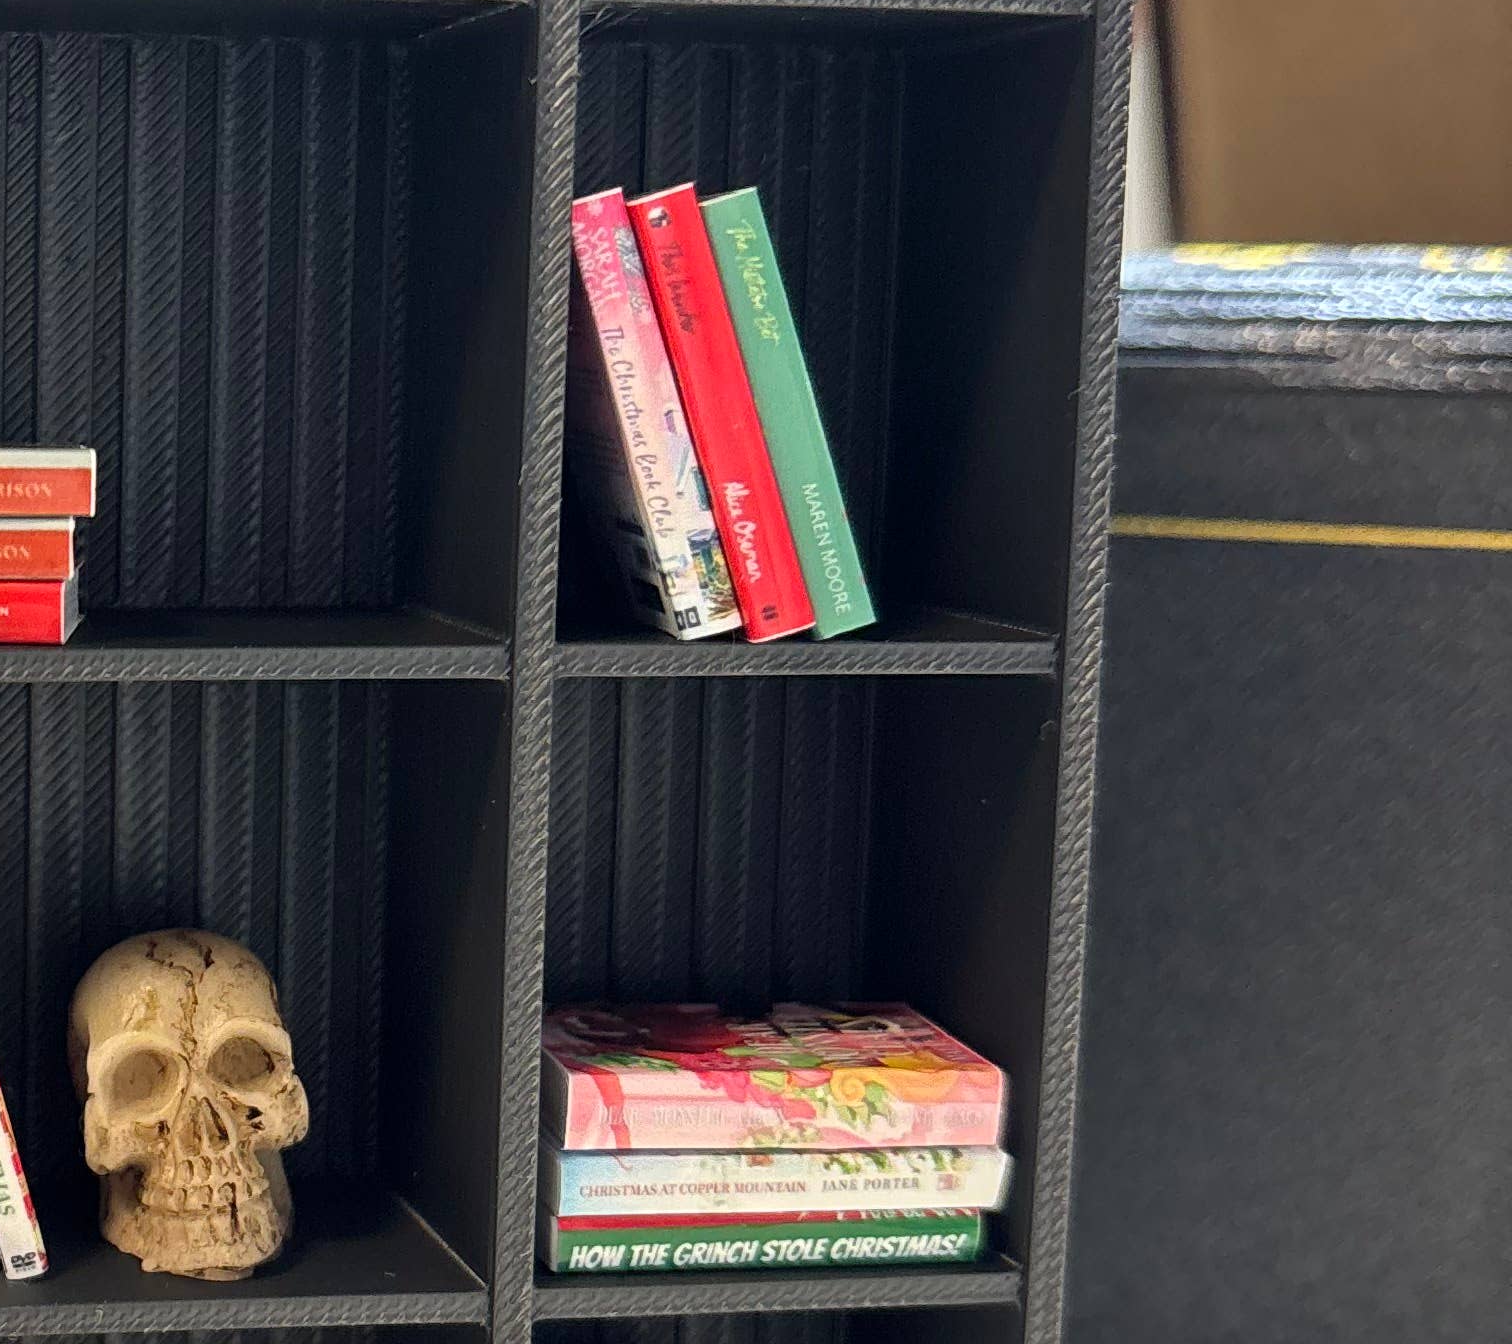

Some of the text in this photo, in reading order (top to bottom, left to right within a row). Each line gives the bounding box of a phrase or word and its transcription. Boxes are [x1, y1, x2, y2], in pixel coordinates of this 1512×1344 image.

[611, 357, 652, 447] Christmas
[638, 452, 664, 490] Book
[648, 494, 675, 539] Club
[802, 482, 851, 613] MAREN MOORE
[580, 1180, 806, 1198] CHRISTMAS AT COPPER MOUNTAIN
[822, 1176, 921, 1192] JANE PORTER
[568, 1233, 969, 1269] HOW THE GRINCH STOLE CHRISTMAS!
